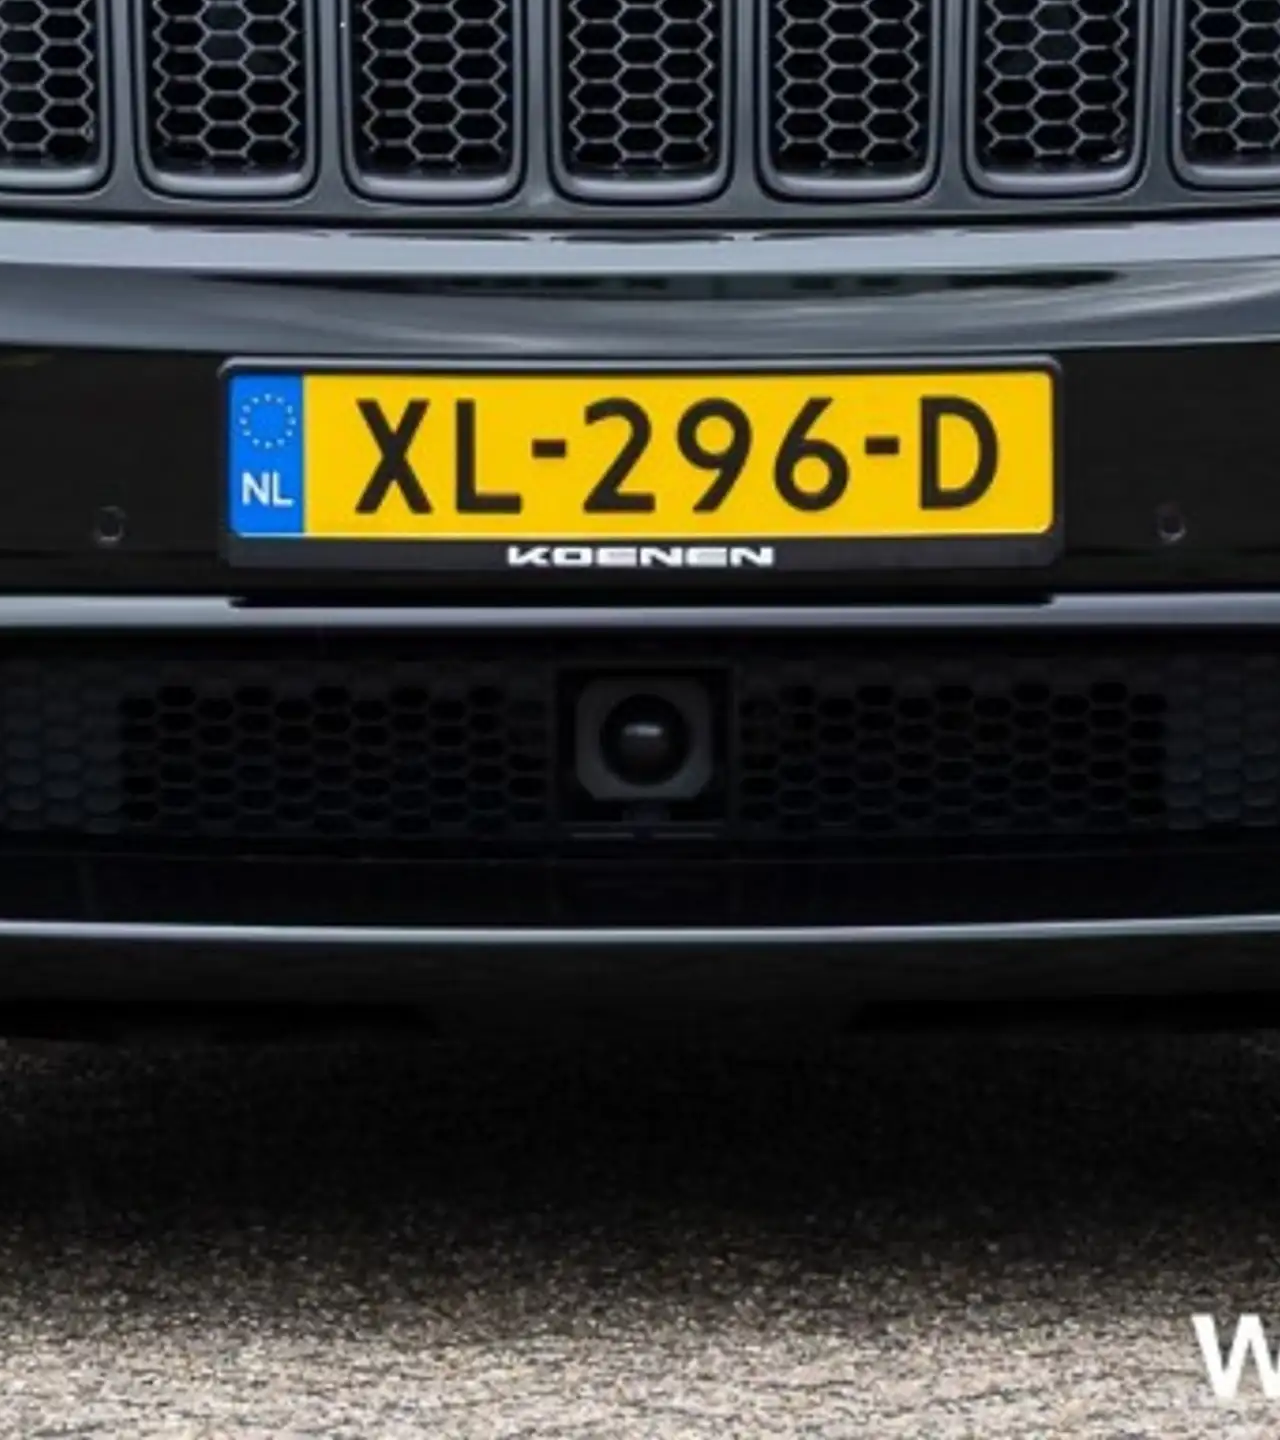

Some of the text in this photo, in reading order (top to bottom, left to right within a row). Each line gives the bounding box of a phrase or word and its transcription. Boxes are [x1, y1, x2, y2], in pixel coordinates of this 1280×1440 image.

[354, 397, 999, 514] XL-296-D
[241, 472, 293, 507] NL
[507, 545, 775, 567] KOENEN
